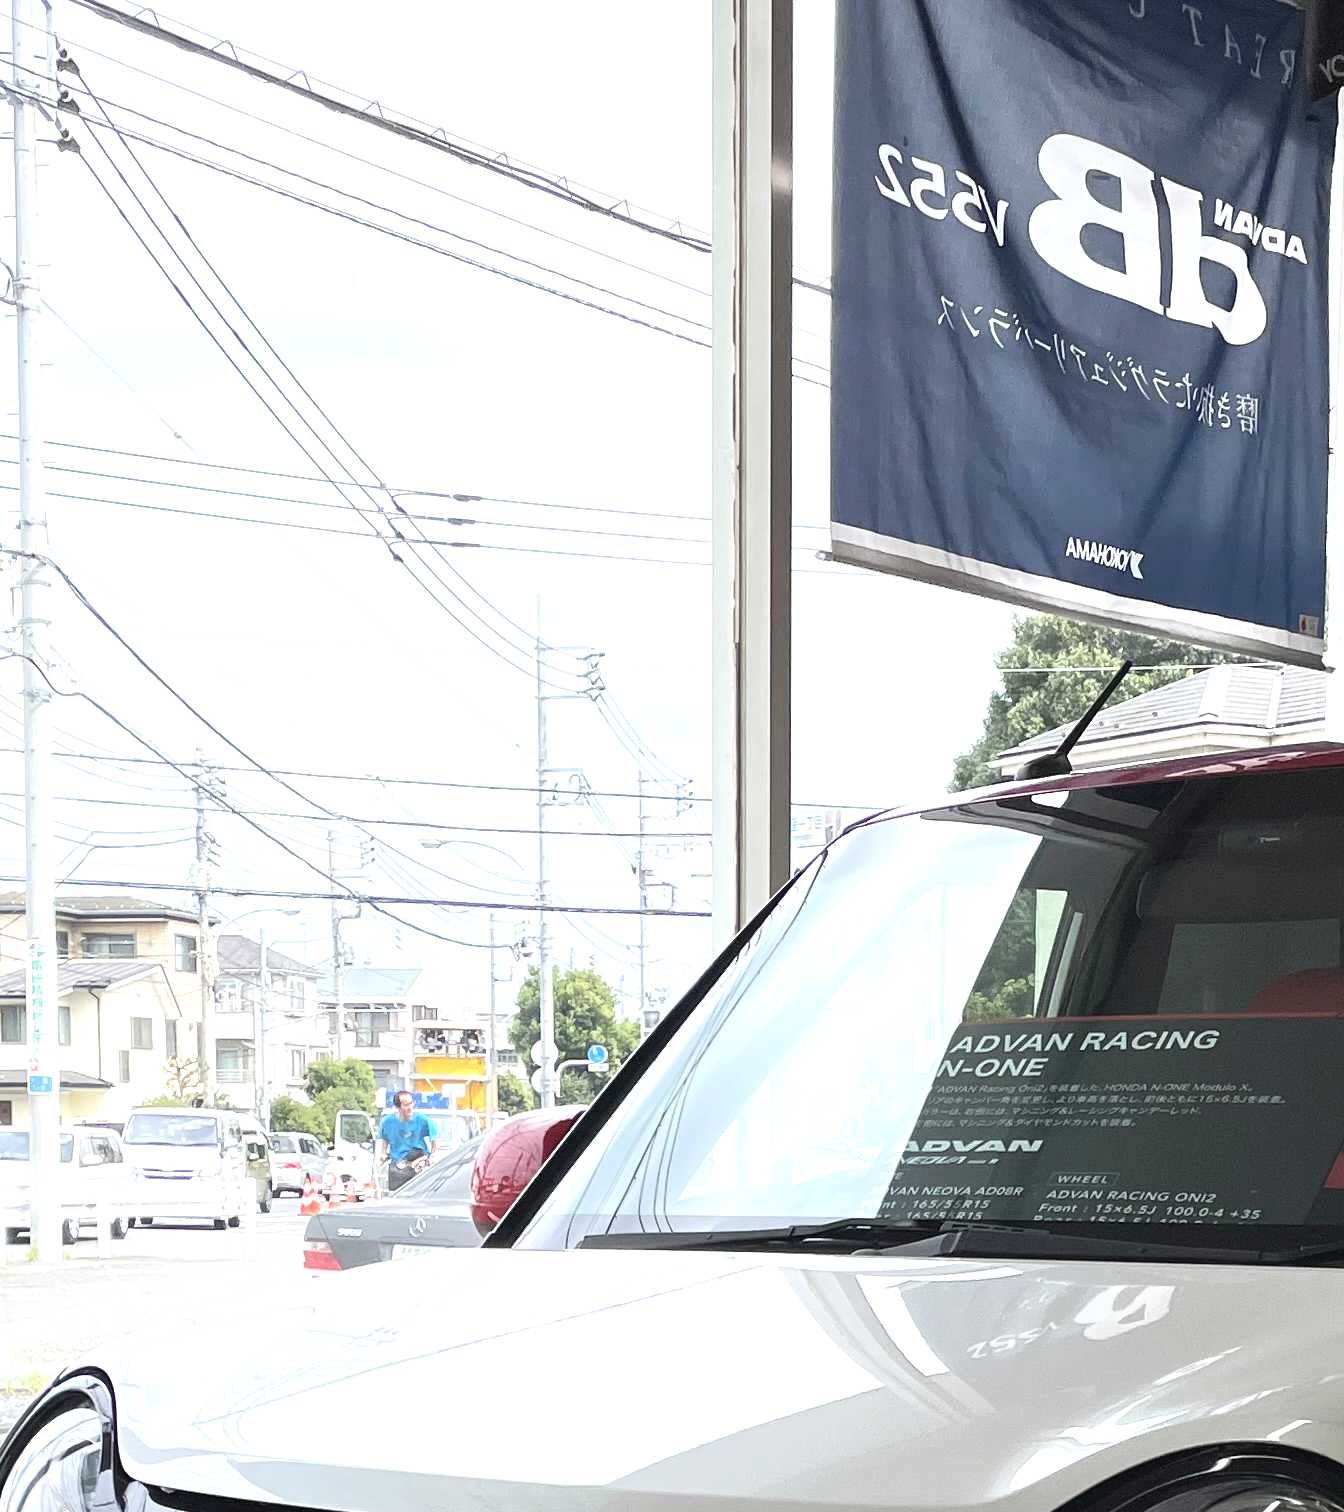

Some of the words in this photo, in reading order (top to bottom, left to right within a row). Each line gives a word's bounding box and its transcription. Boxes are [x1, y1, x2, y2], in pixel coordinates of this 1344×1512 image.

[949, 1031, 1073, 1054] ADVAN
[1079, 1029, 1221, 1053] RACING
[936, 1057, 1049, 1078] N-ONE
[905, 1139, 1044, 1153] ADVAN
[1056, 1175, 1109, 1185] WHEEL
[921, 1186, 971, 1196] NEOVA
[1046, 1189, 1103, 1200] ADVAN
[1106, 1191, 1170, 1202] RACING
[1174, 1192, 1217, 1204] ONI2
[1038, 1203, 1078, 1214] Front
[1229, 1208, 1262, 1220] +35
